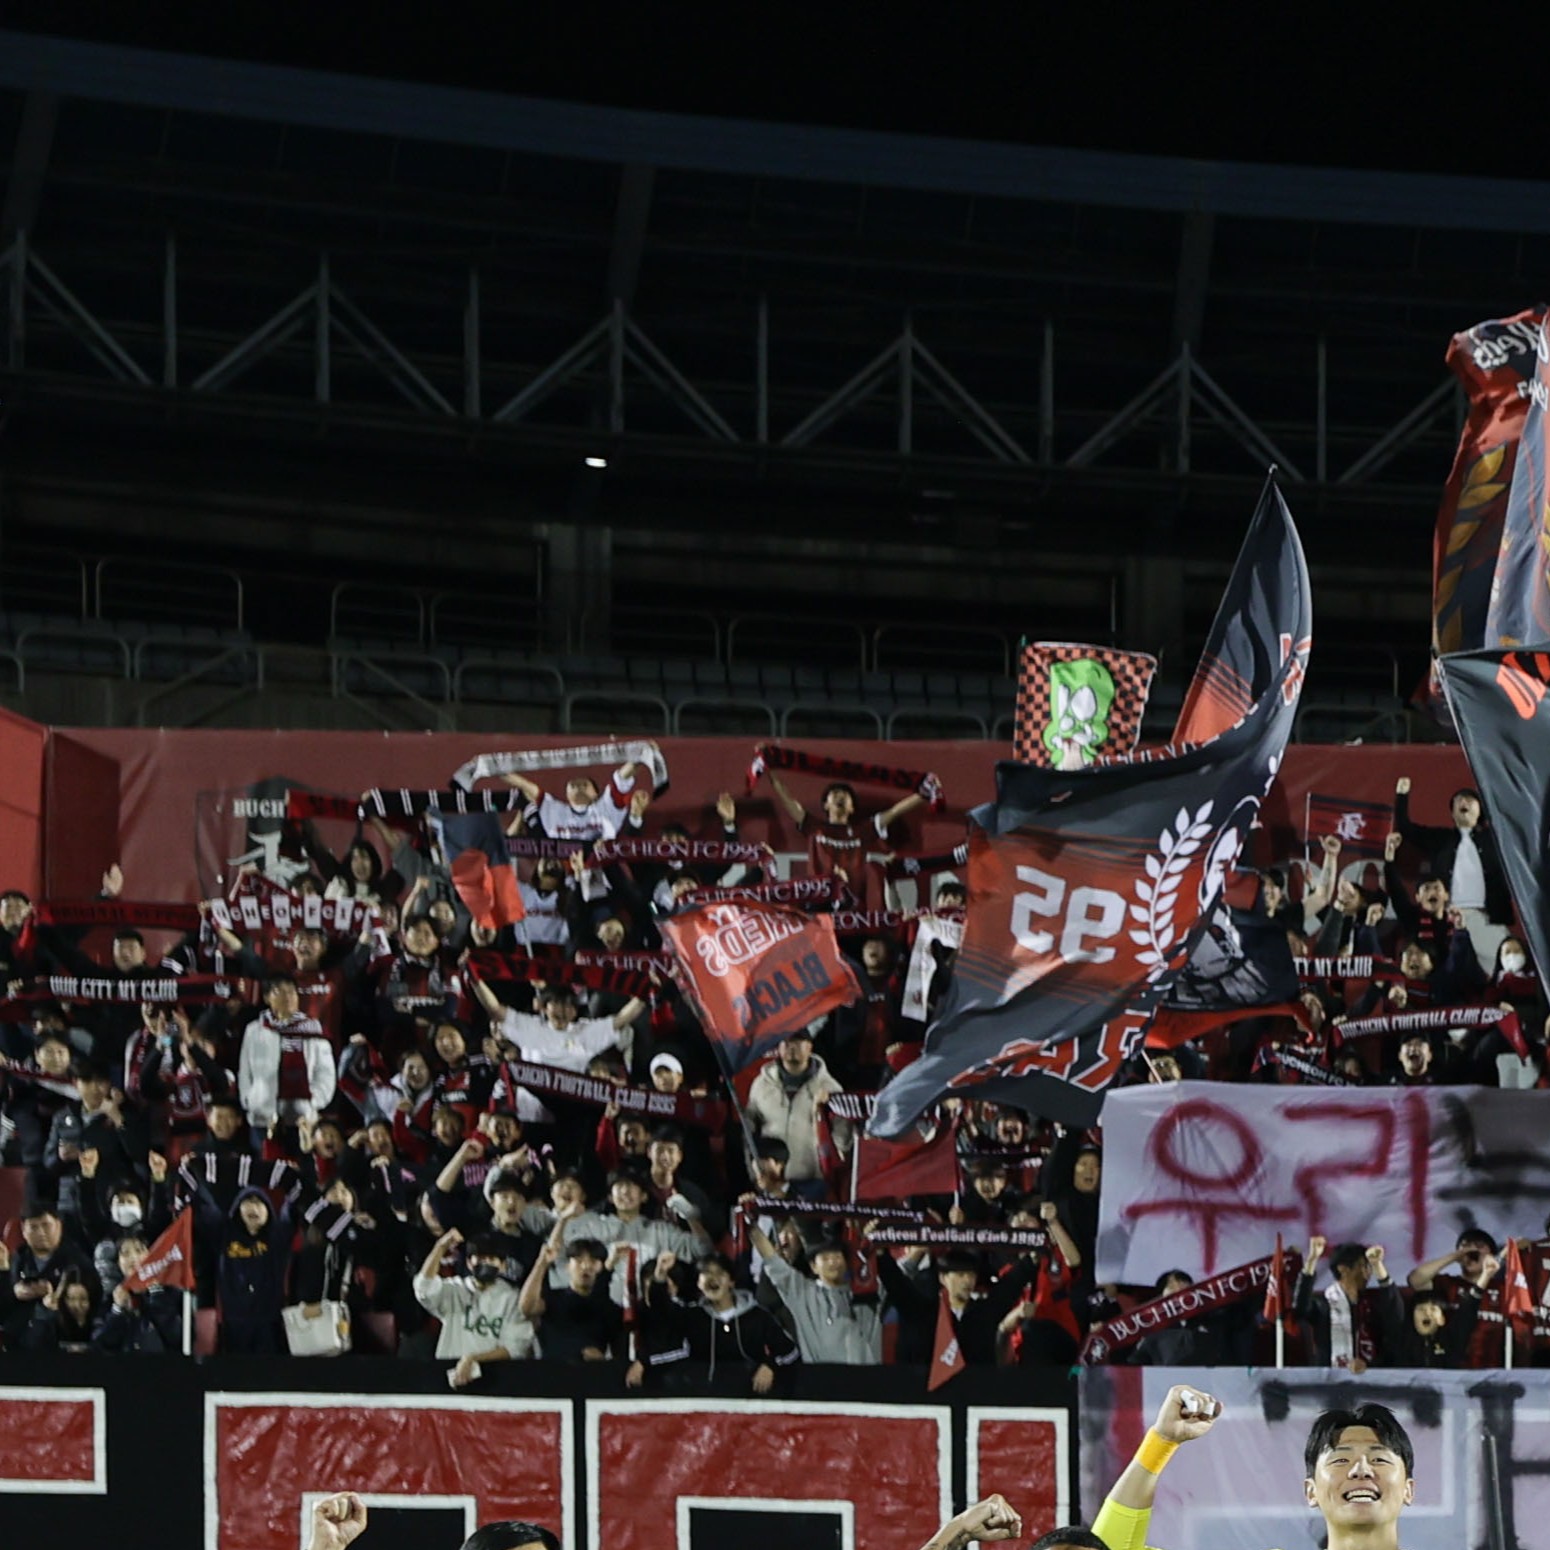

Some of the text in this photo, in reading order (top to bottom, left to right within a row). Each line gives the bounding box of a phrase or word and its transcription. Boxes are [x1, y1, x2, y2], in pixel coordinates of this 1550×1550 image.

[1336, 955, 1373, 976] CLUB
[140, 977, 178, 1001] CLUB
[463, 1305, 504, 1339] Lee
